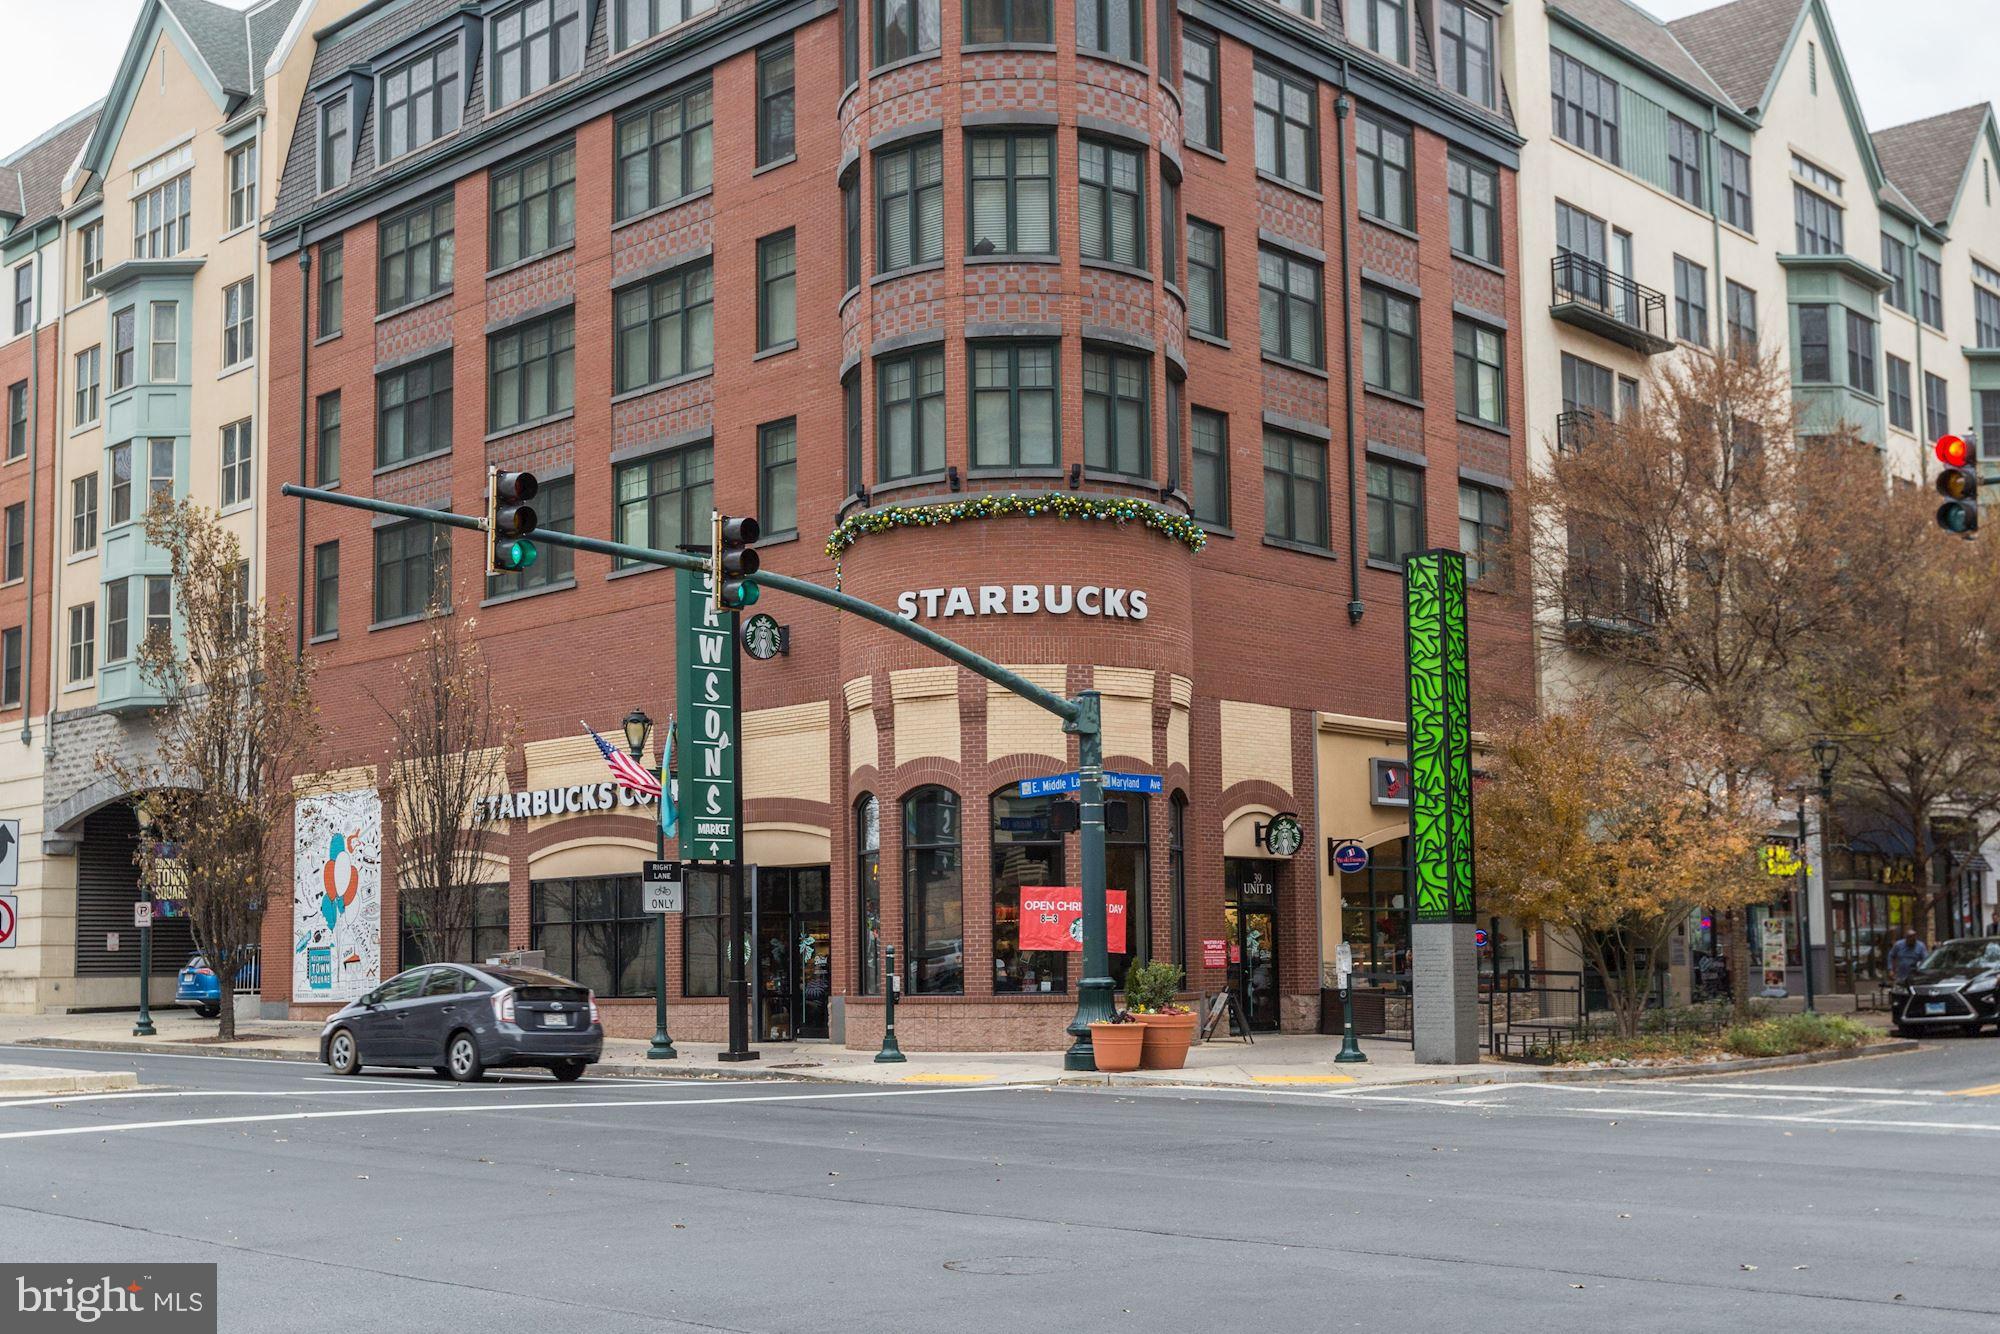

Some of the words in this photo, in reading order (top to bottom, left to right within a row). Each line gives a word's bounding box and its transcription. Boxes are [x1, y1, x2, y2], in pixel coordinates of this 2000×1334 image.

[897, 585, 1149, 620] STARBUCKS
[698, 570, 725, 816] AWSONS
[1032, 783, 1040, 794] E.
[1042, 779, 1067, 792] Middle
[1111, 774, 1140, 790] Maryland
[1149, 779, 1161, 790] Ave
[473, 782, 613, 823] STARBUCKS
[697, 823, 730, 836] MARKET
[653, 872, 672, 880] LANE
[1253, 872, 1263, 884] 39
[1243, 883, 1265, 895] UNIT
[1266, 883, 1273, 895] B
[651, 899, 674, 909] ONLY
[1024, 900, 1055, 911] OPEN
[1108, 903, 1124, 914] DAY
[311, 963, 330, 974] TOWN
